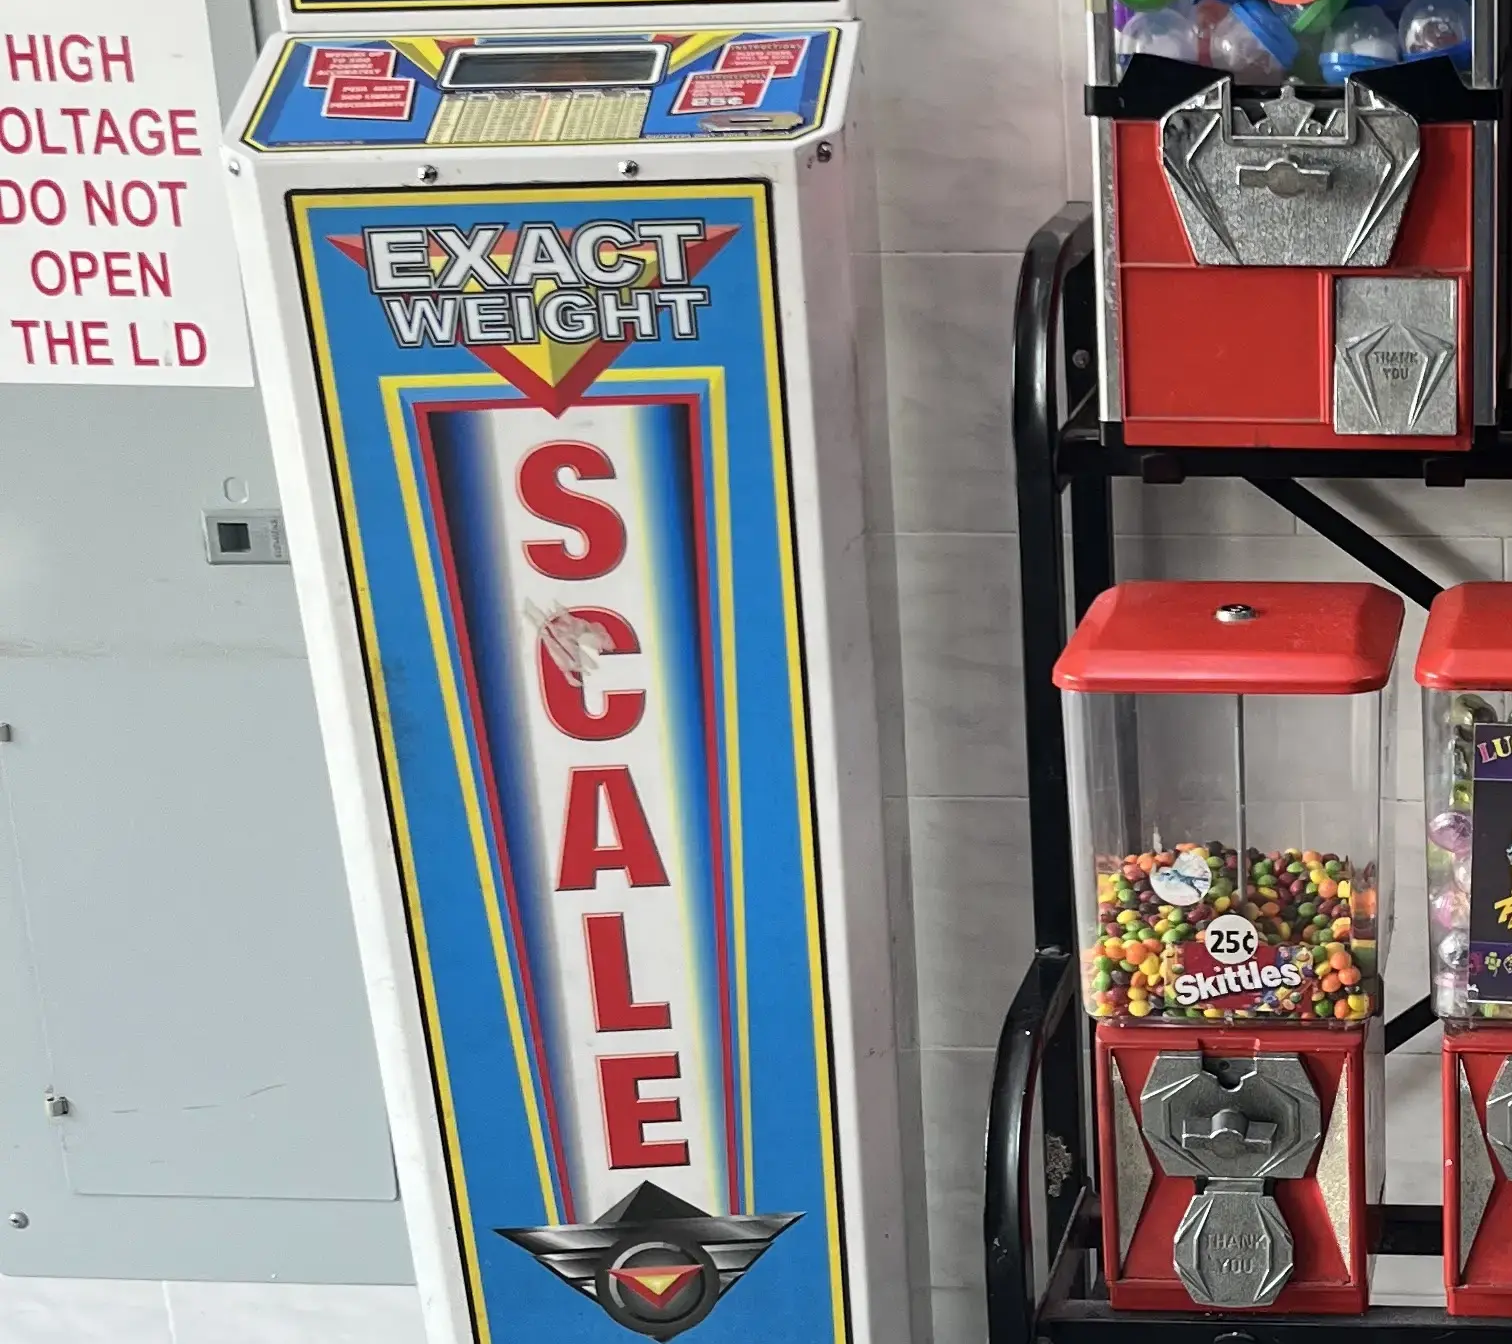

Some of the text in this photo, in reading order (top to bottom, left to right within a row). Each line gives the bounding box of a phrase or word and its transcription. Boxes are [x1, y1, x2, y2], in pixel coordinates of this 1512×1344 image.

[5, 34, 135, 83] HIGH
[0, 178, 187, 227] DO NOT
[31, 249, 172, 297] OPEN
[362, 218, 705, 293] EXACT
[382, 286, 709, 347] WEIGHT
[11, 319, 114, 366] THE
[1382, 367, 1409, 381] YOU
[1210, 930, 1254, 955] 25¢
[1175, 961, 1302, 1005] Skittles
[1206, 1234, 1267, 1250] THANK
[1216, 1258, 1253, 1273] YOU
